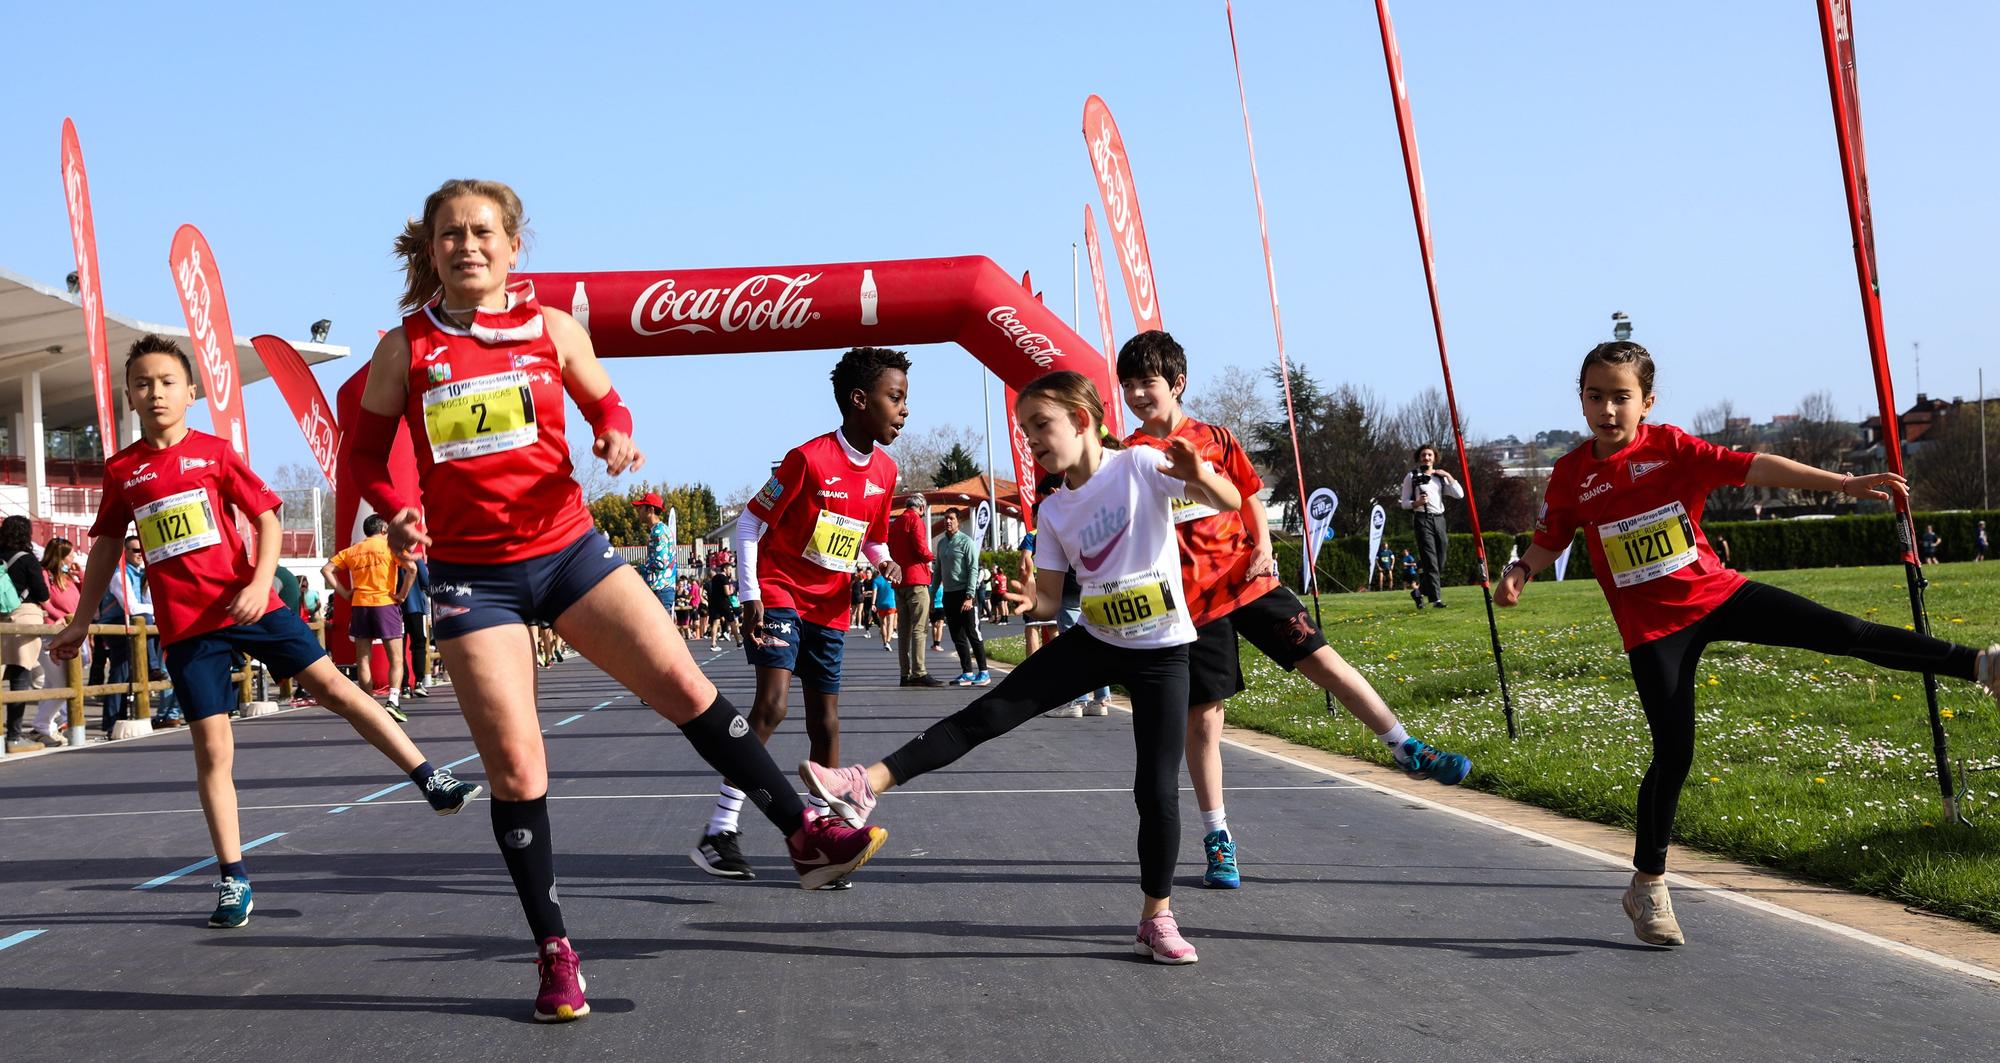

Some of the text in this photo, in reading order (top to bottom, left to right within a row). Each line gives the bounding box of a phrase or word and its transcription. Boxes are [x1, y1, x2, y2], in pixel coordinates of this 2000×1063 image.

[631, 272, 823, 336] Coca-Cola
[987, 305, 1067, 368] Coca-Cola
[447, 385, 461, 397] 10
[470, 403, 492, 434] 2
[156, 512, 192, 543] 1121
[1078, 503, 1128, 551] nike
[1617, 521, 1629, 533] 10
[827, 532, 855, 558] 1125
[1625, 530, 1674, 567] 1120
[1102, 582, 1112, 594] 10
[1103, 595, 1152, 625] 1196
